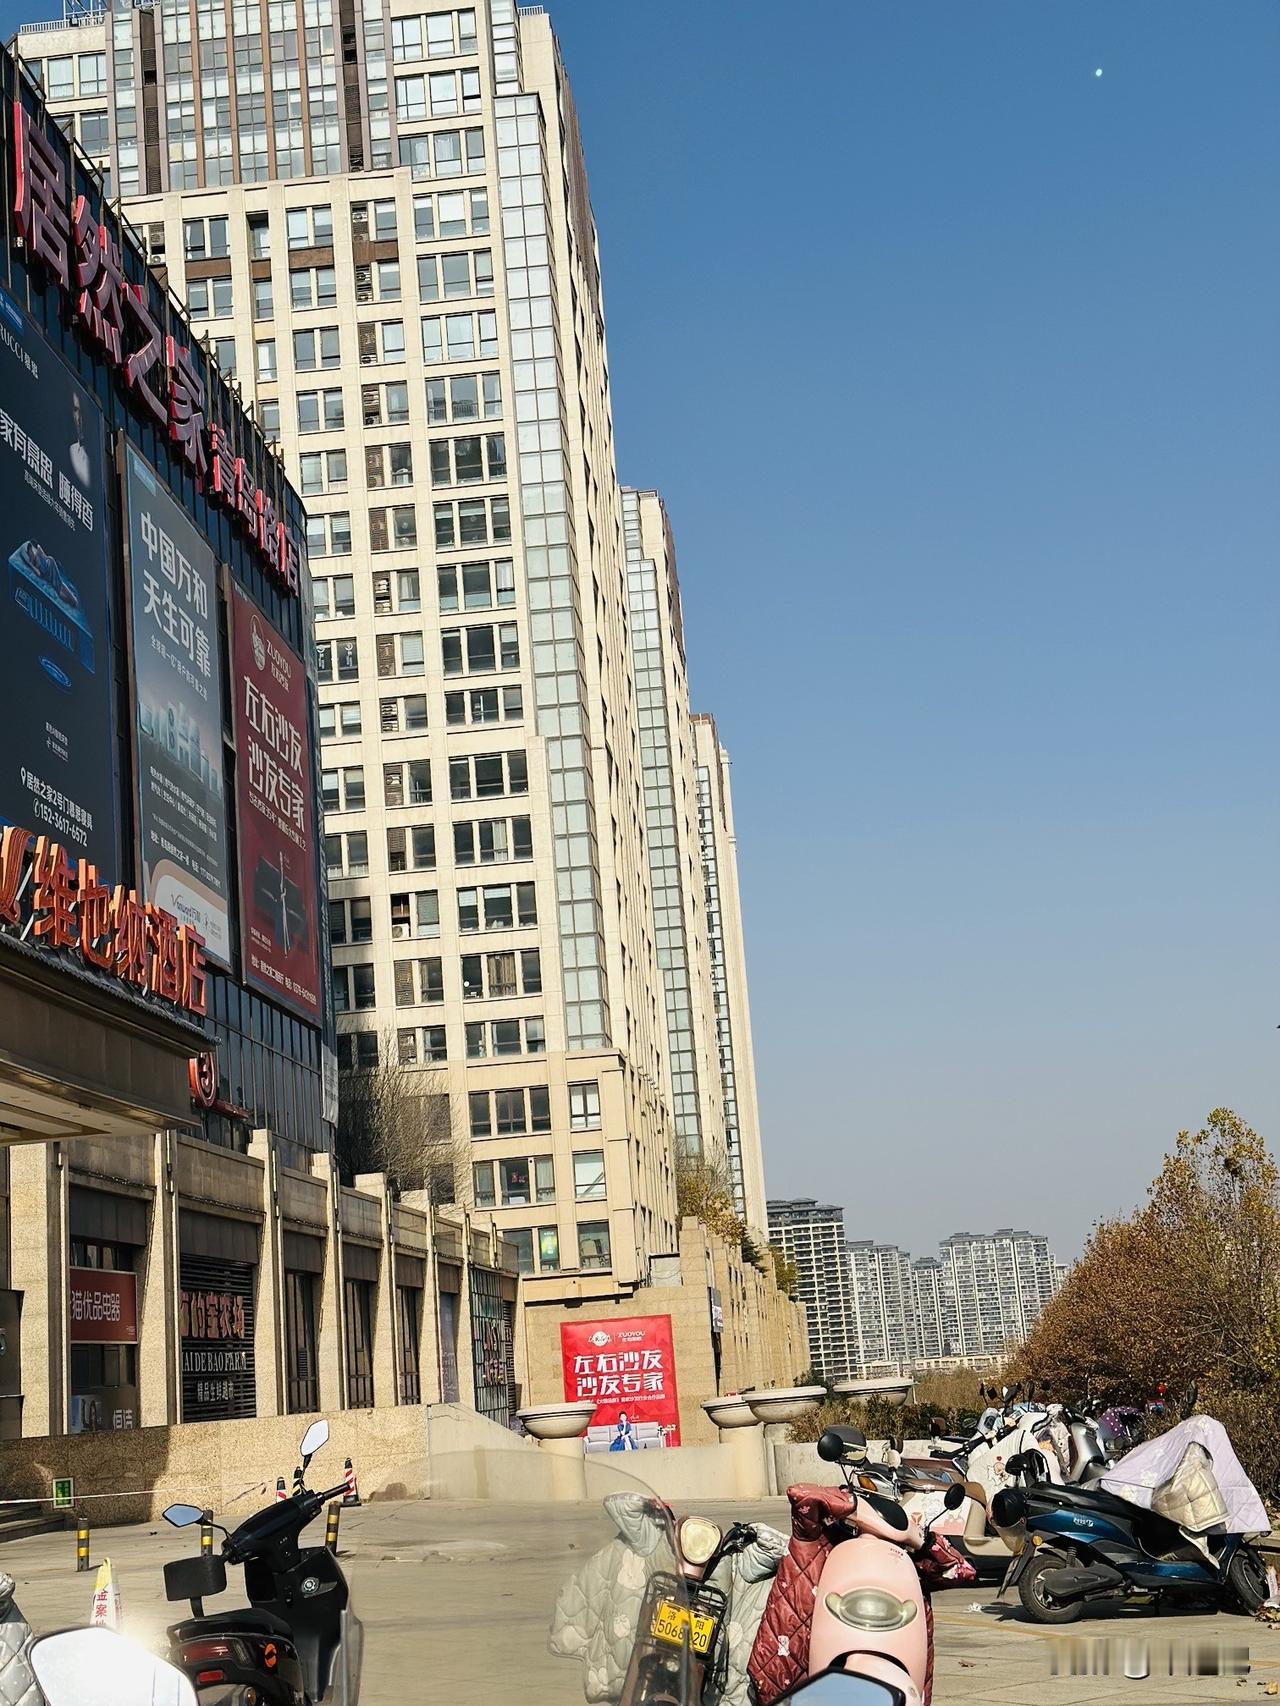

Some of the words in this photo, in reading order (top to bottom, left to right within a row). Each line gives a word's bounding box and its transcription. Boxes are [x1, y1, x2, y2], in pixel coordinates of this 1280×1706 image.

[139, 510, 209, 621] 中国万和
[142, 567, 212, 679] 天生可靠
[242, 674, 305, 779] 左右沙发
[246, 734, 306, 834] 沙发专家
[33, 834, 208, 1017] 维也纳酒店
[69, 1290, 121, 1323] 猫优品电器
[573, 1349, 664, 1375] 左右沙发
[576, 1371, 665, 1398] 沙发专家
